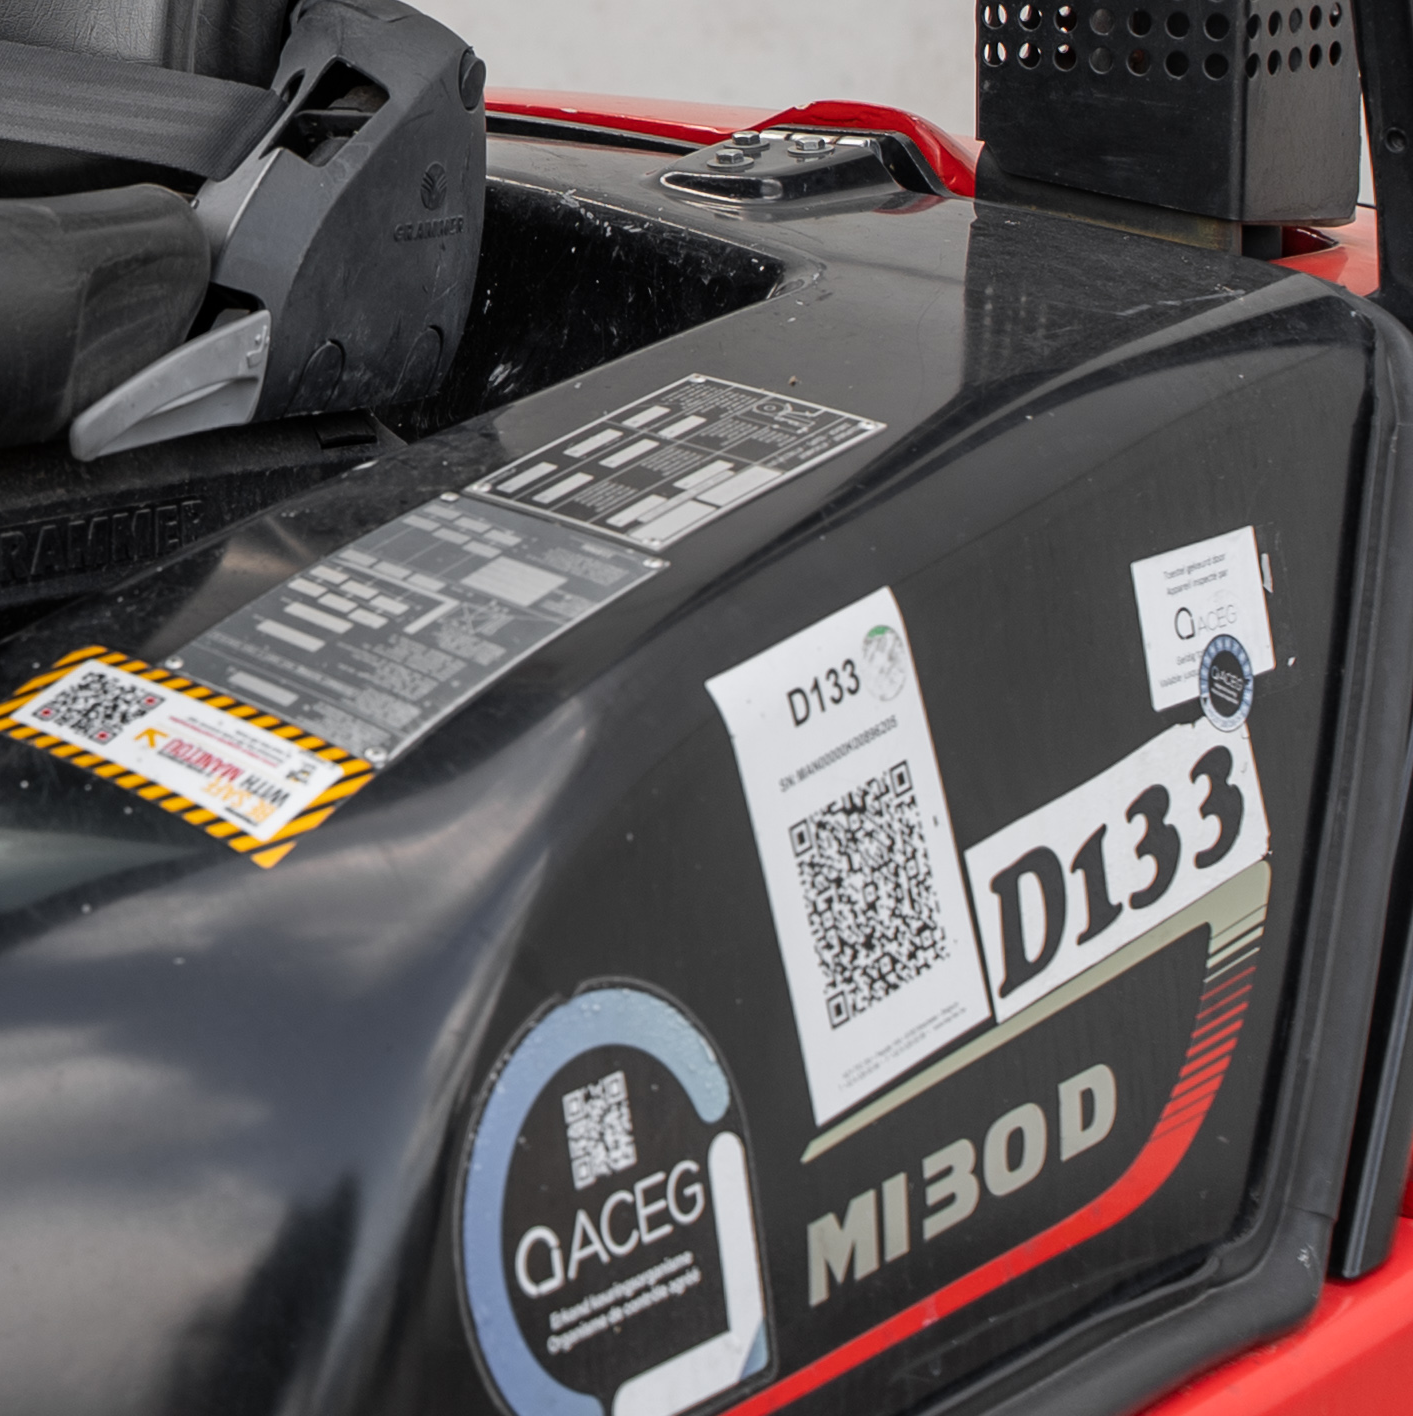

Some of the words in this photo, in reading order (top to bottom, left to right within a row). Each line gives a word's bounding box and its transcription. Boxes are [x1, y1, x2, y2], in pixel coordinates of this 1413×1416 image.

[393, 214, 465, 242] GRAMMER
[786, 657, 861, 728] D133
[161, 738, 245, 782] MANITOU
[239, 773, 291, 808] WITH
[989, 744, 1245, 1000] D133
